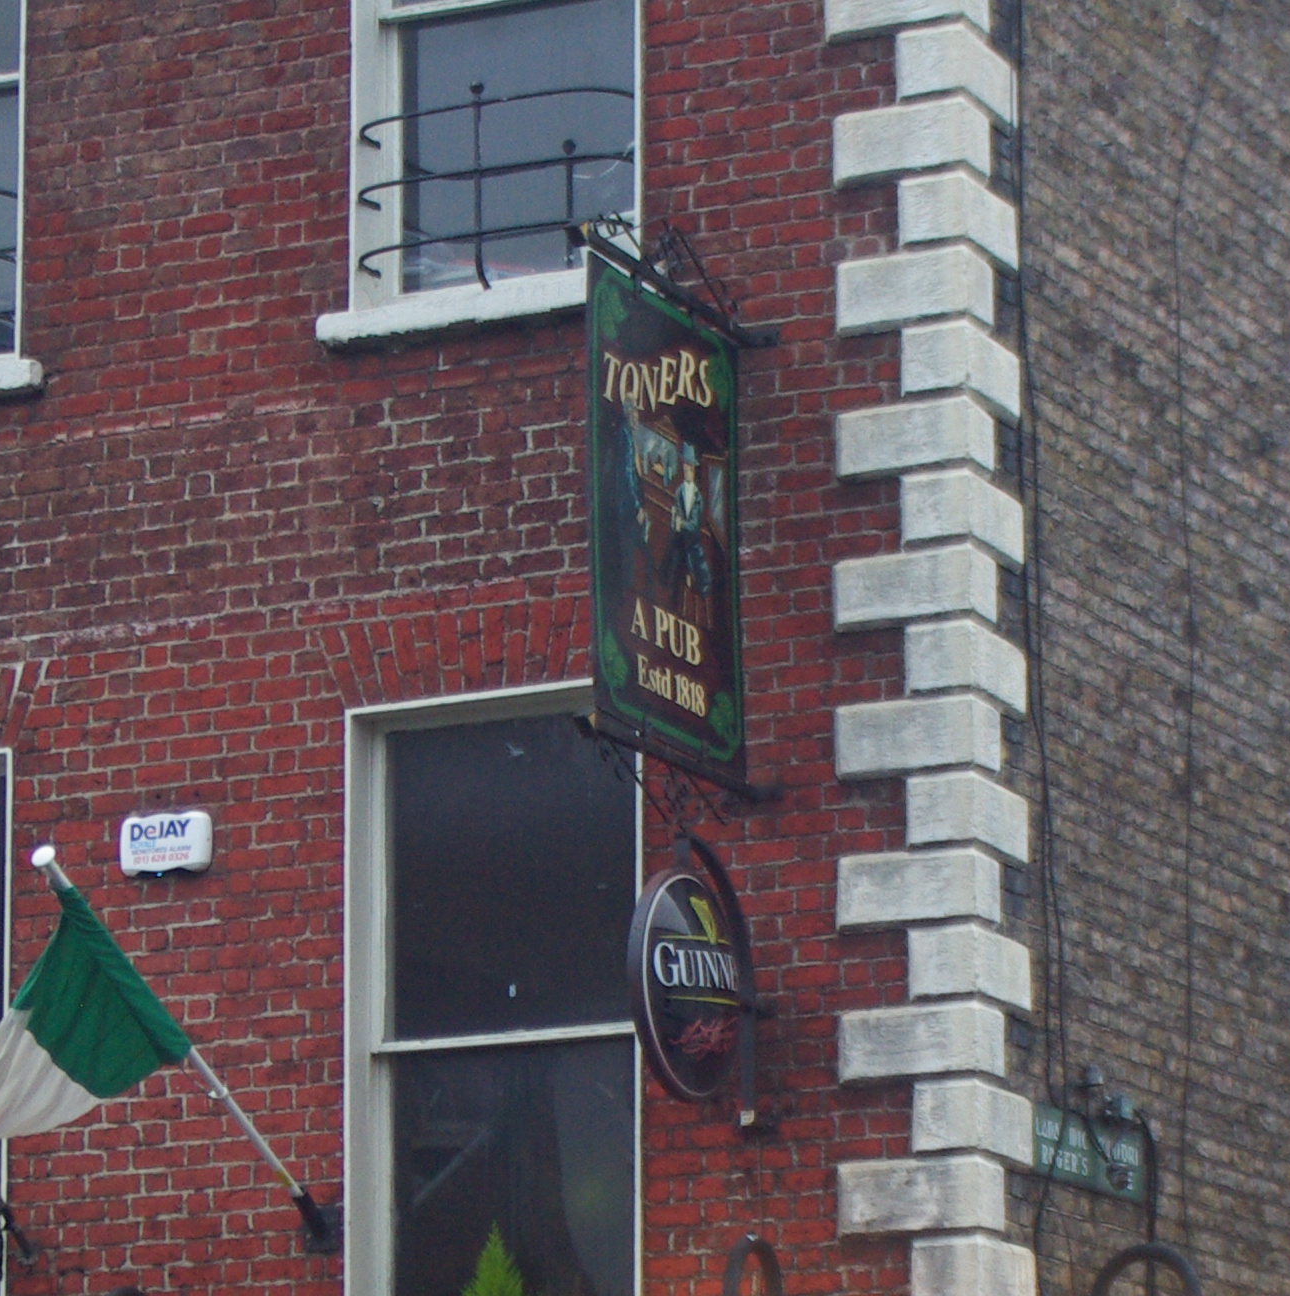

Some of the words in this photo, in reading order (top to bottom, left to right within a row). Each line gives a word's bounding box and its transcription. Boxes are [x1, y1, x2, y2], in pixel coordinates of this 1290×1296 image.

[603, 350, 712, 412] TONERS
[630, 597, 648, 642] A
[654, 604, 701, 667] PUB
[636, 653, 672, 701] Estd
[674, 672, 707, 718] 1818
[654, 942, 739, 991] GUINNE
